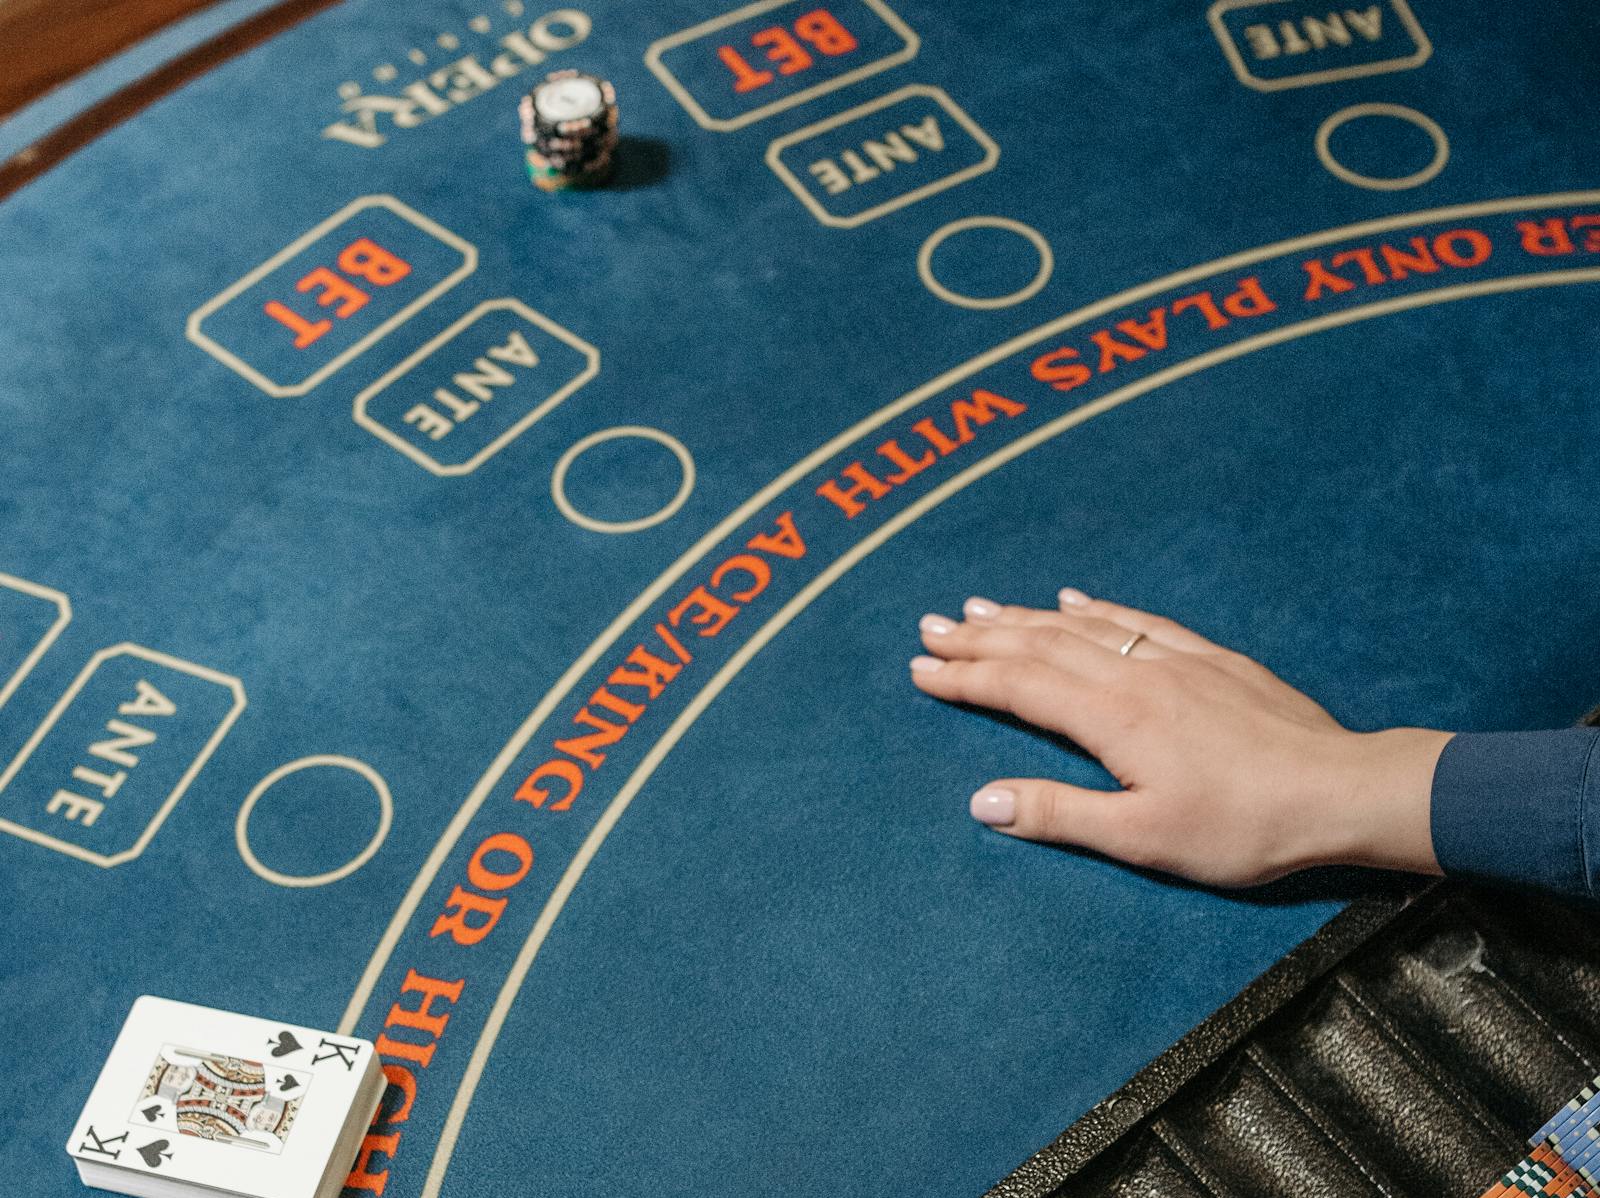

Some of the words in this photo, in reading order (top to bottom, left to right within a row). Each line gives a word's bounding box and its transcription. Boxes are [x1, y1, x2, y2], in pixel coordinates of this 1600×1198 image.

[322, 8, 592, 148] OPERA
[716, 8, 858, 93] BET
[1244, 5, 1382, 60] ANTE
[809, 114, 945, 195] ANTE
[264, 237, 412, 349] BET
[1303, 229, 1493, 300] ONLY
[403, 332, 539, 440] ANTE
[1030, 278, 1277, 391] PLAYS
[816, 389, 1026, 519] WITH
[513, 511, 807, 811] ACE/KING
[46, 679, 177, 827] ANTE
[431, 832, 534, 946] OR
[311, 1037, 361, 1072] K
[78, 1124, 129, 1160] K
